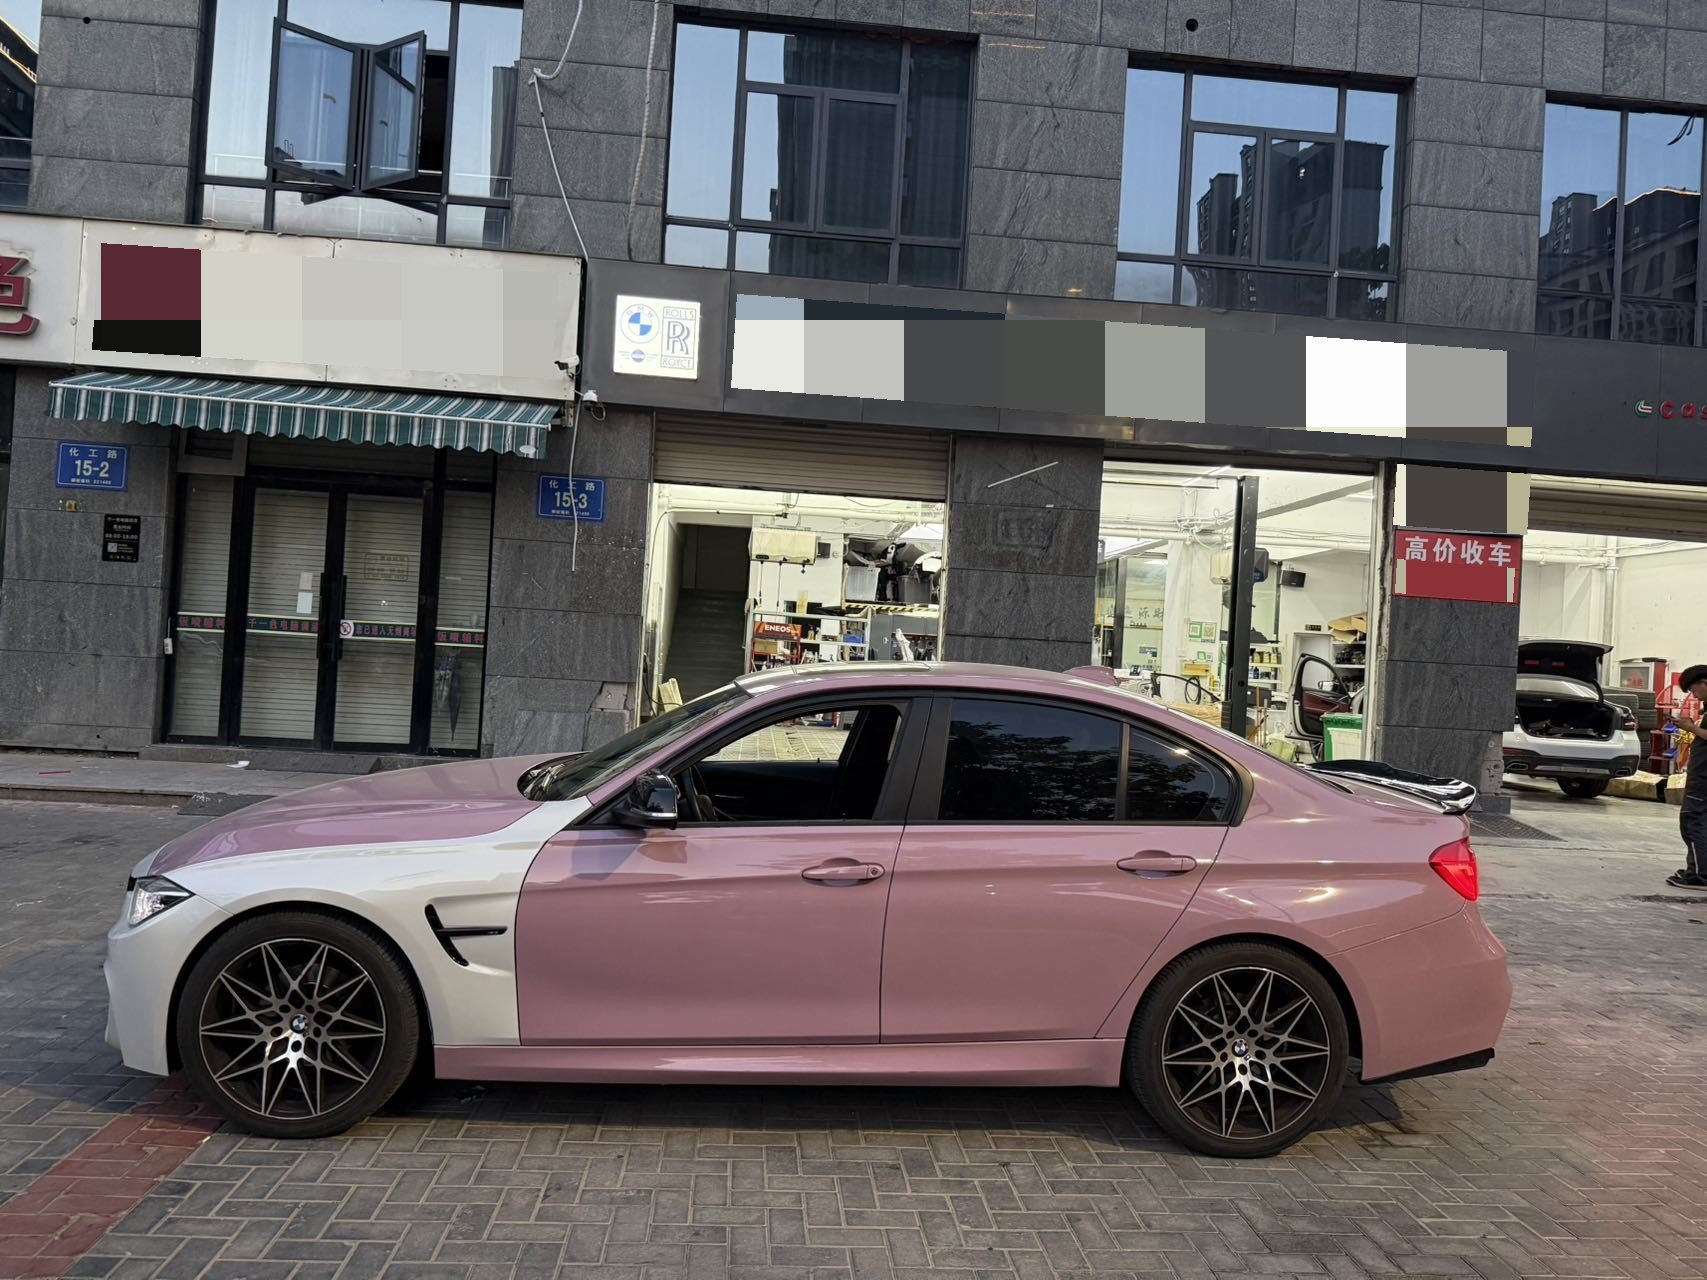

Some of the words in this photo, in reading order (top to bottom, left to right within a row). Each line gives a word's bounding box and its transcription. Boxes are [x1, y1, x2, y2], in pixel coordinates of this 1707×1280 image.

[69, 447, 117, 459] 化工路
[75, 459, 109, 477] 15-2
[549, 479, 595, 492] 化工路
[554, 491, 588, 509] 15-3
[1405, 536, 1512, 567] 高价收车
[764, 624, 792, 633] ENEOS
